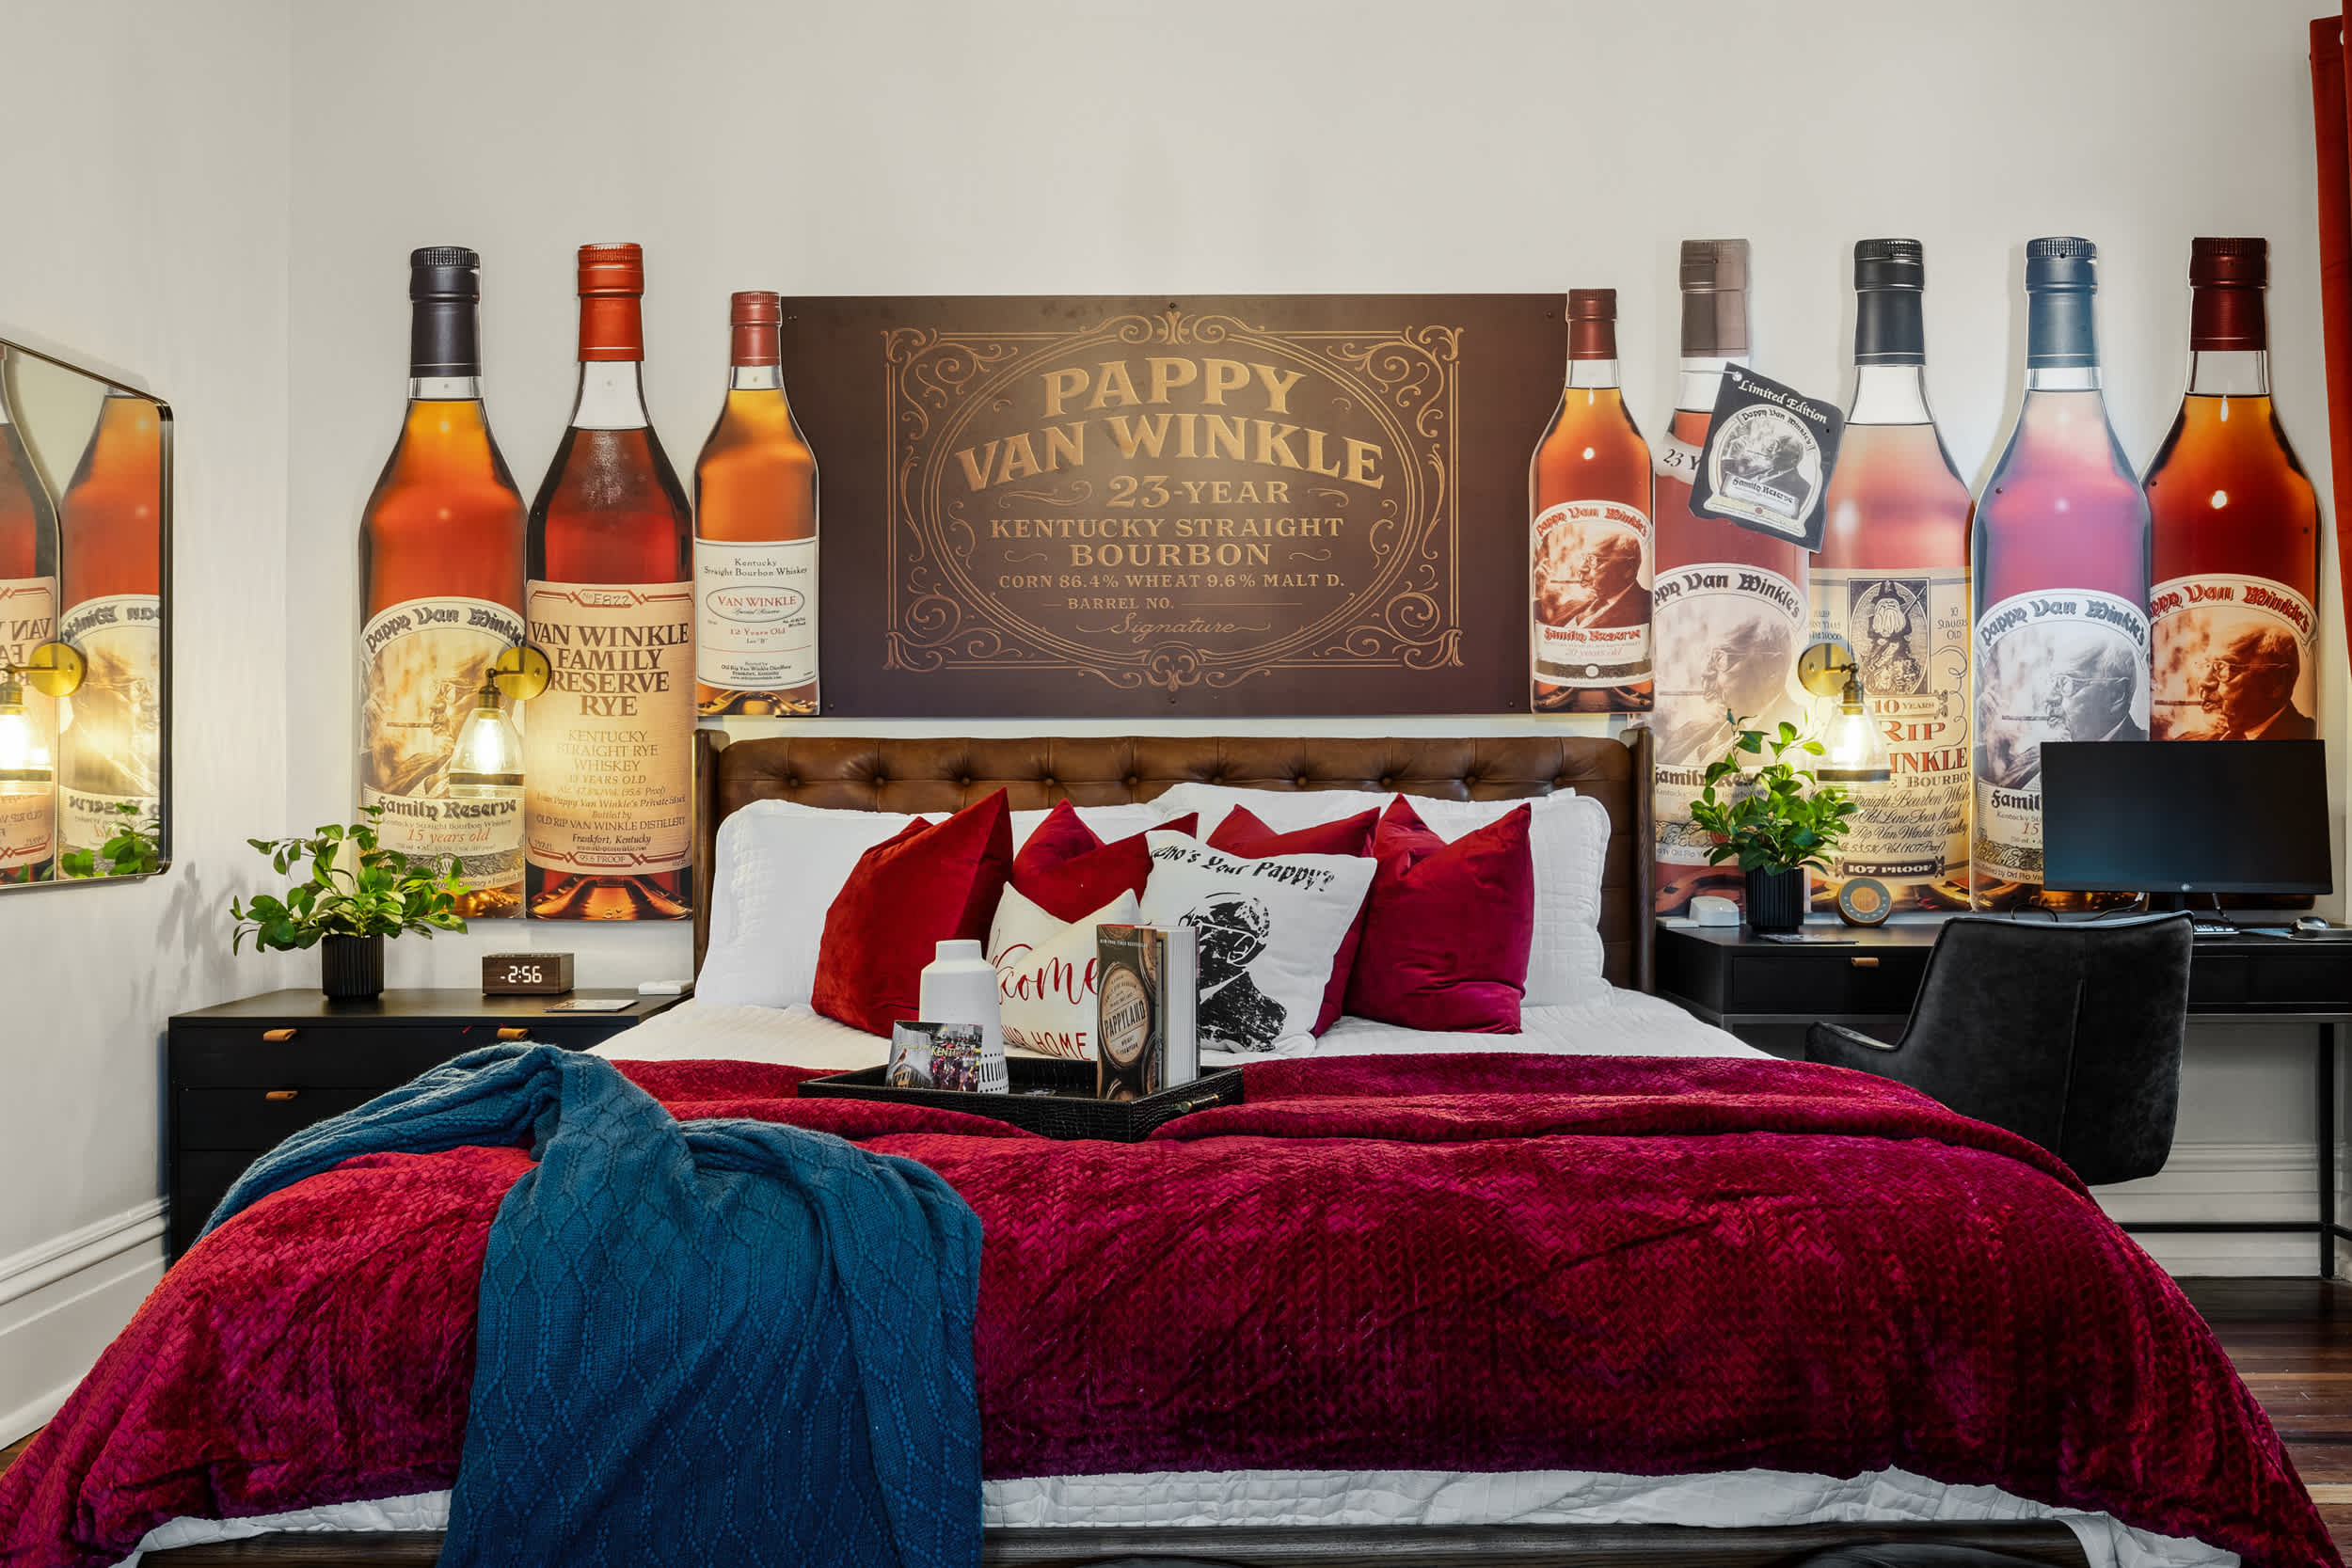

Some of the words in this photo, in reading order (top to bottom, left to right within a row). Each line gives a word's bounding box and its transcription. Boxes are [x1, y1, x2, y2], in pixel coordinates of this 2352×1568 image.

[1040, 357, 1307, 419] PAPPY
[1739, 380, 1787, 405] Limited
[1787, 398, 1827, 423] Edition
[955, 420, 1085, 491] VAN
[1104, 414, 1385, 489] WINKLE
[1663, 448, 1685, 467] 23
[1107, 475, 1291, 508] 23-YEAR
[989, 518, 1165, 539] KENTUCKY
[1175, 517, 1343, 538] STRAIGHT
[735, 558, 777, 567] Kentucky
[1069, 544, 1272, 566] BOURBON
[704, 566, 732, 577] Straight
[736, 568, 773, 577] Bourbon
[999, 575, 1053, 590] CORN
[1059, 575, 1119, 590] 86.4%
[1124, 575, 1200, 590] WHEAT
[1207, 574, 1256, 590] 9.6%
[1263, 573, 1320, 588] MALT
[1327, 572, 1345, 588] D.
[718, 595, 742, 607] VAN
[745, 594, 797, 608] WINKLE
[1068, 596, 1139, 610] BARREL
[1146, 596, 1174, 610] NO.
[1682, 572, 1729, 591] Van
[1736, 573, 1801, 619] Winkle's
[2184, 583, 2234, 602] Van
[365, 614, 413, 654] Pappy
[412, 607, 460, 626] Van
[1109, 612, 1239, 642] Signature
[1980, 606, 2029, 647] Pappy
[2030, 598, 2077, 617] Van
[530, 621, 571, 645] VAN
[576, 623, 690, 647] WINKLE
[557, 648, 664, 672] FAMILY
[549, 670, 670, 694] RESERVE
[580, 694, 639, 717] RYE
[1874, 700, 1899, 714] 10
[568, 730, 647, 743] KENTUCKY
[557, 744, 630, 757] STRAIGHT
[633, 745, 659, 757] RYE
[1890, 747, 1967, 774] INKLE
[574, 759, 641, 771] WHISKEY
[582, 775, 618, 784] YEARS
[622, 775, 646, 784] OLD
[377, 795, 438, 821] Family
[443, 799, 516, 820] Reserve
[1992, 790, 2041, 811] Famil
[570, 819, 592, 830] VAN
[595, 820, 638, 832] WINKLE
[2022, 822, 2041, 836] 15
[407, 829, 425, 841] 15
[430, 832, 465, 845] years
[469, 828, 491, 841] old
[615, 833, 651, 845] Kentucky
[596, 855, 626, 863] PROOF
[1848, 864, 1878, 874] 107
[1881, 864, 1933, 875] PROOF
[1104, 999, 1146, 1039] PAPPYLAND
[1031, 1031, 1091, 1062] HOME
